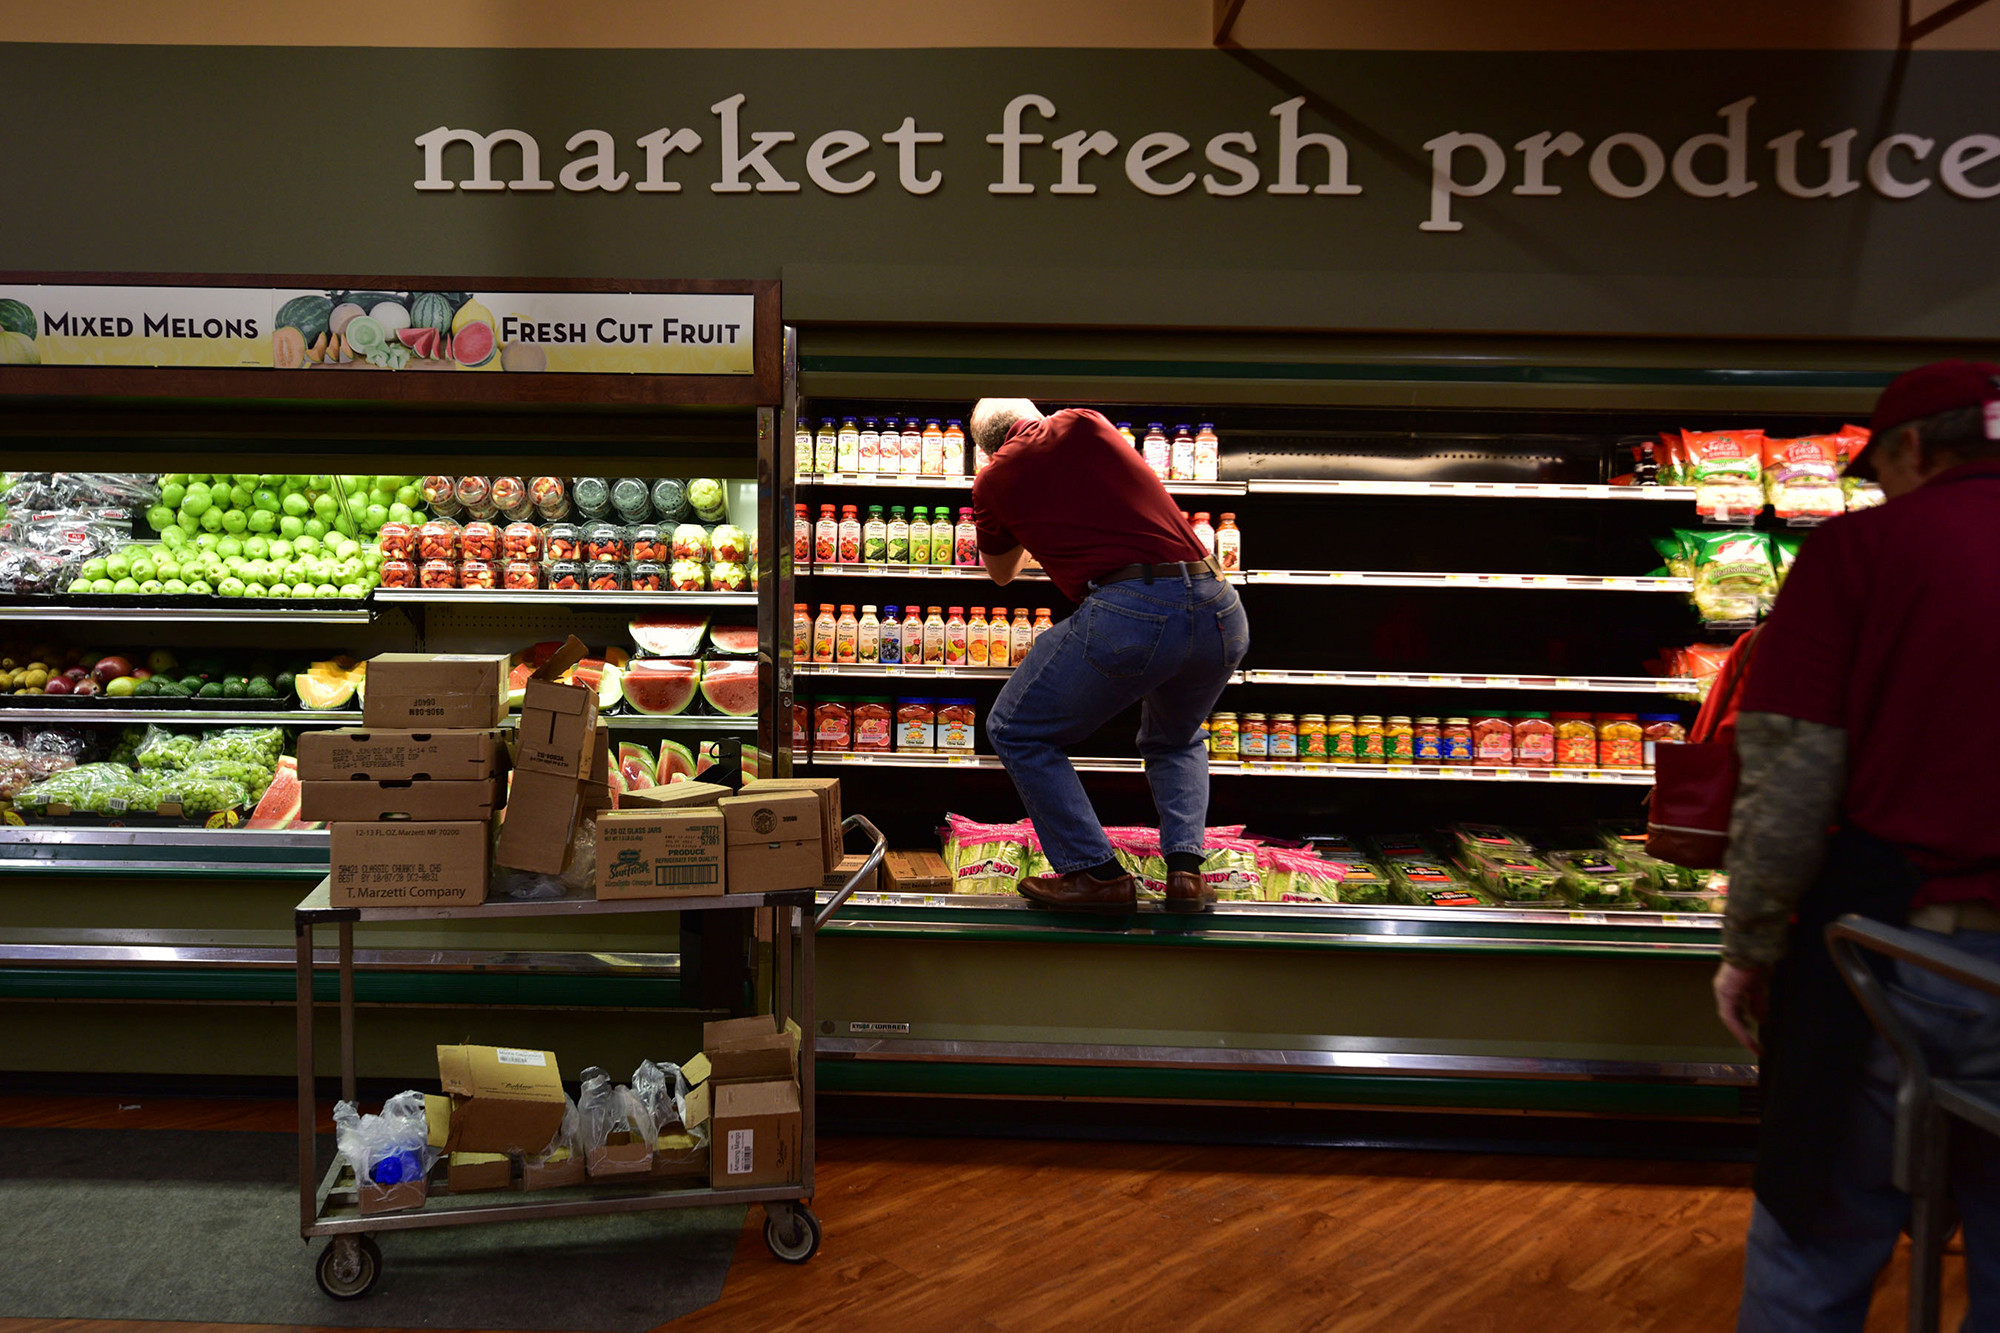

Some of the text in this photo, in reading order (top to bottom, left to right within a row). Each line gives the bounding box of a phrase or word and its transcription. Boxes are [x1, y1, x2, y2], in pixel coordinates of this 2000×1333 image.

[413, 92, 2000, 232] market fresh produce
[668, 848, 706, 856] PRODUCE
[957, 861, 1018, 878] ANDY BOY
[338, 873, 354, 883] BEST
[361, 873, 371, 883] BY
[346, 886, 467, 899] T. Marzetti Company
[733, 1132, 742, 1172] Amazing Mango
